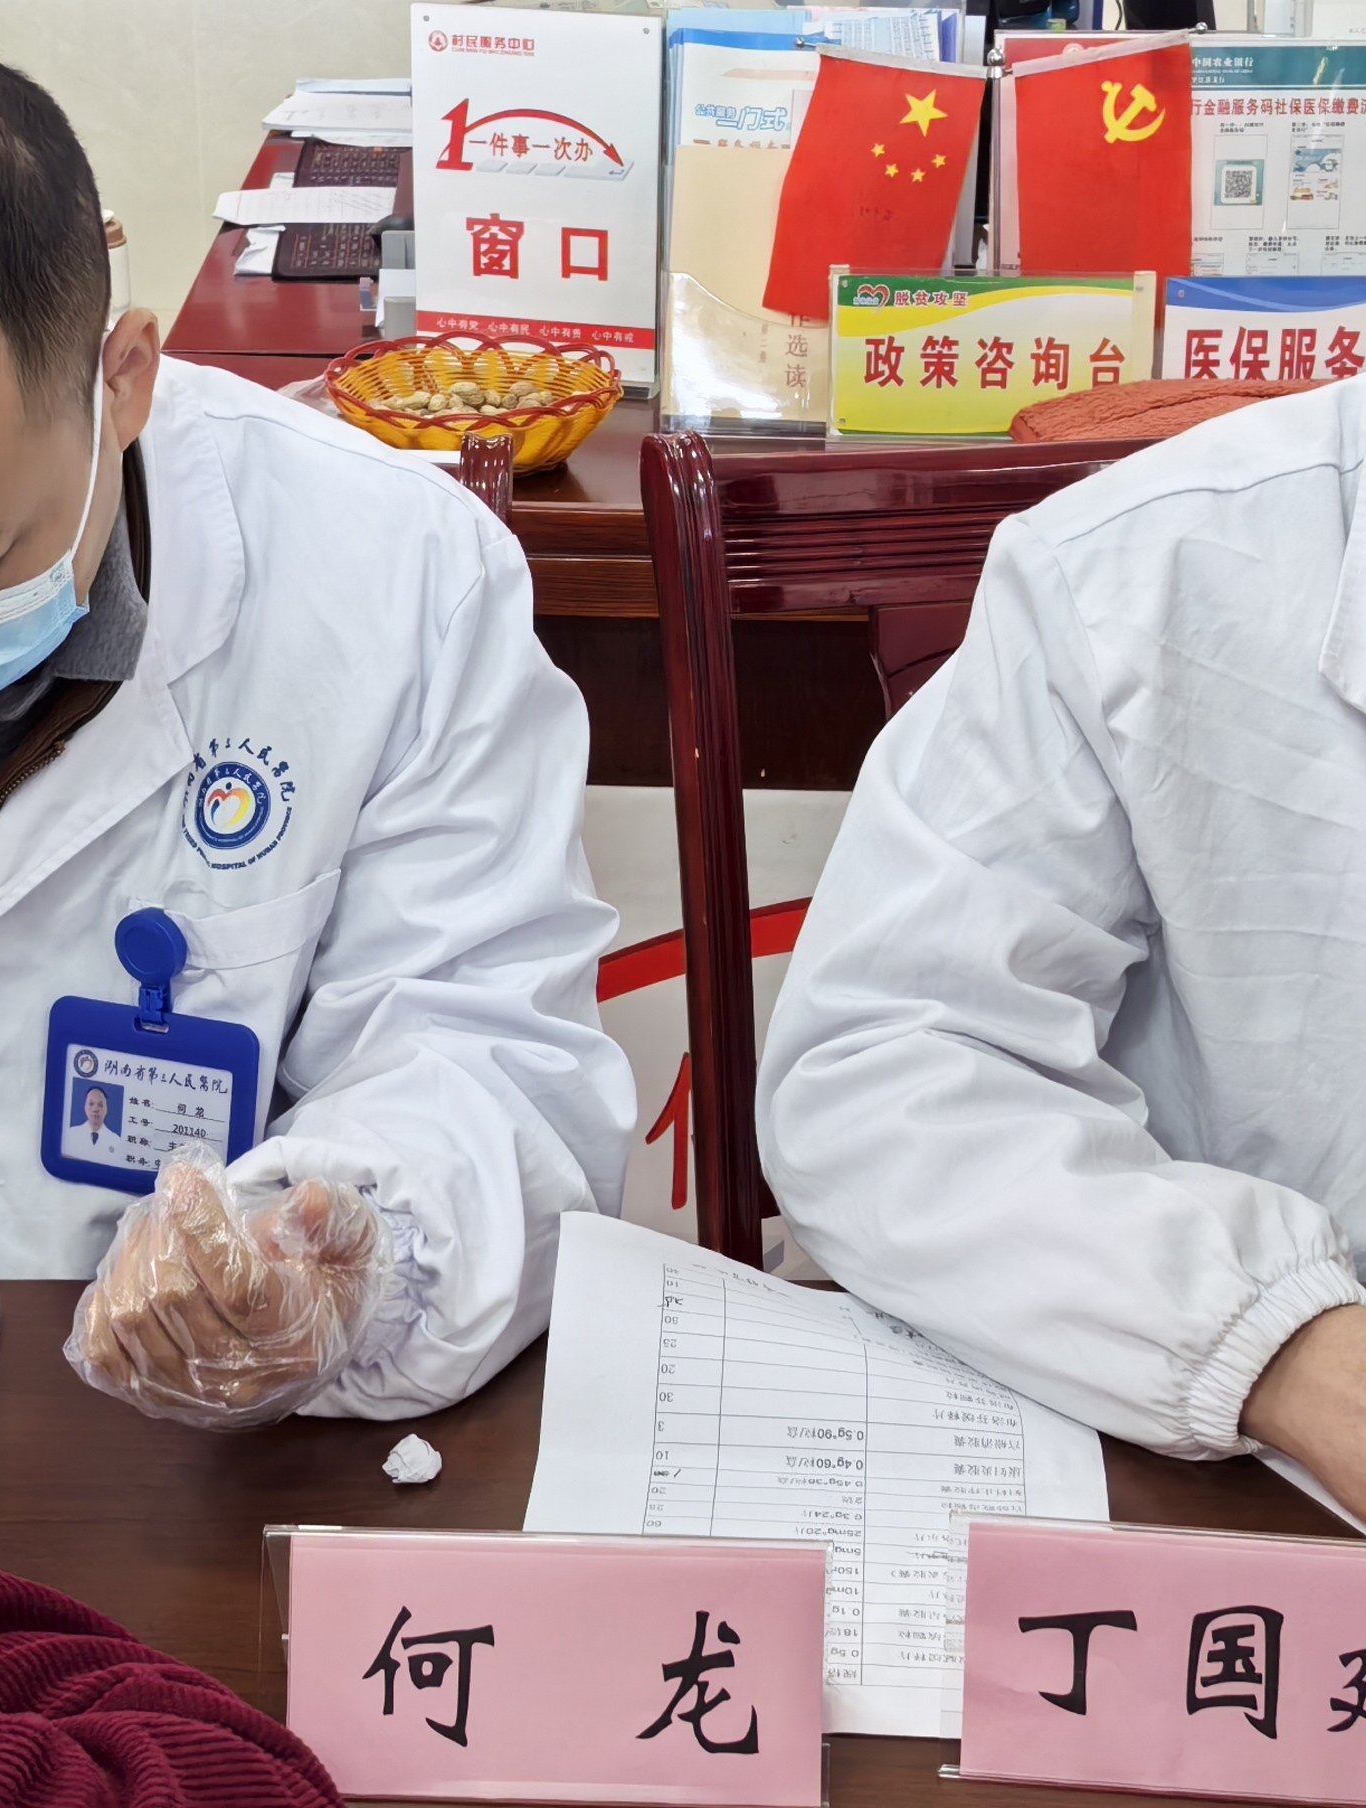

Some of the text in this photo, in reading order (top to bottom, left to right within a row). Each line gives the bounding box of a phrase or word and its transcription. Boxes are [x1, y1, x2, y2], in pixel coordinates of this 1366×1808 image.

[451, 34, 535, 51] 村民服务中心
[1191, 56, 1254, 68] 中国农业银行
[715, 107, 787, 131] 一门式
[469, 132, 593, 161] 一件事一次办
[466, 213, 609, 282] 窗口
[893, 290, 969, 307] 脱贫攻坚
[436, 317, 480, 332] 心中有党
[487, 321, 531, 336] 心中有民
[864, 335, 1127, 389] 政策咨询台
[661, 1364, 676, 1374] 20
[658, 1391, 674, 1402] 30
[657, 1421, 665, 1431] 3
[655, 1450, 670, 1460] 10
[646, 1520, 662, 1528] 60
